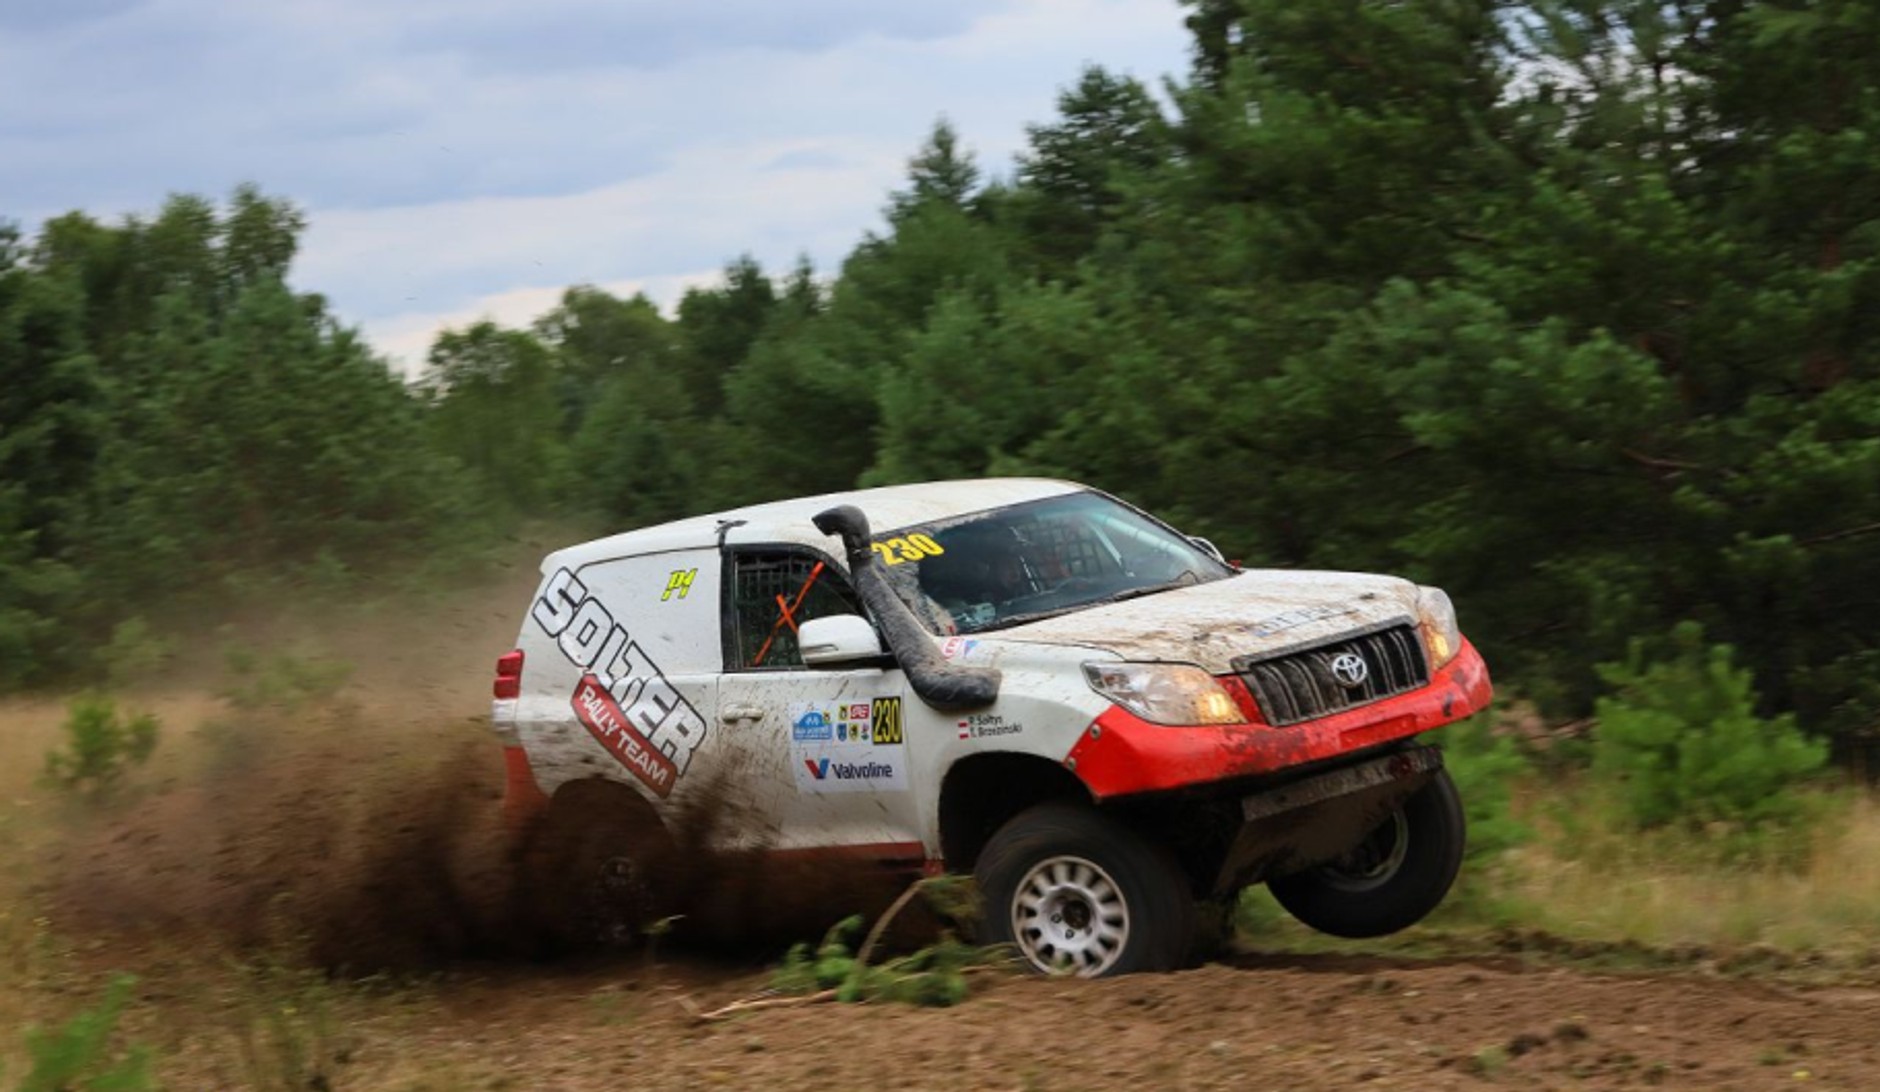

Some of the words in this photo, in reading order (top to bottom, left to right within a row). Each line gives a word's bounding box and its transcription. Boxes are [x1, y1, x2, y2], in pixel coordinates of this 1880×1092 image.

[871, 533, 945, 567] 230
[532, 566, 707, 778] SOLTER
[578, 684, 621, 737] RALLY
[618, 729, 669, 786] TEAM
[873, 698, 901, 743] 230
[831, 762, 893, 779] Valvoline
